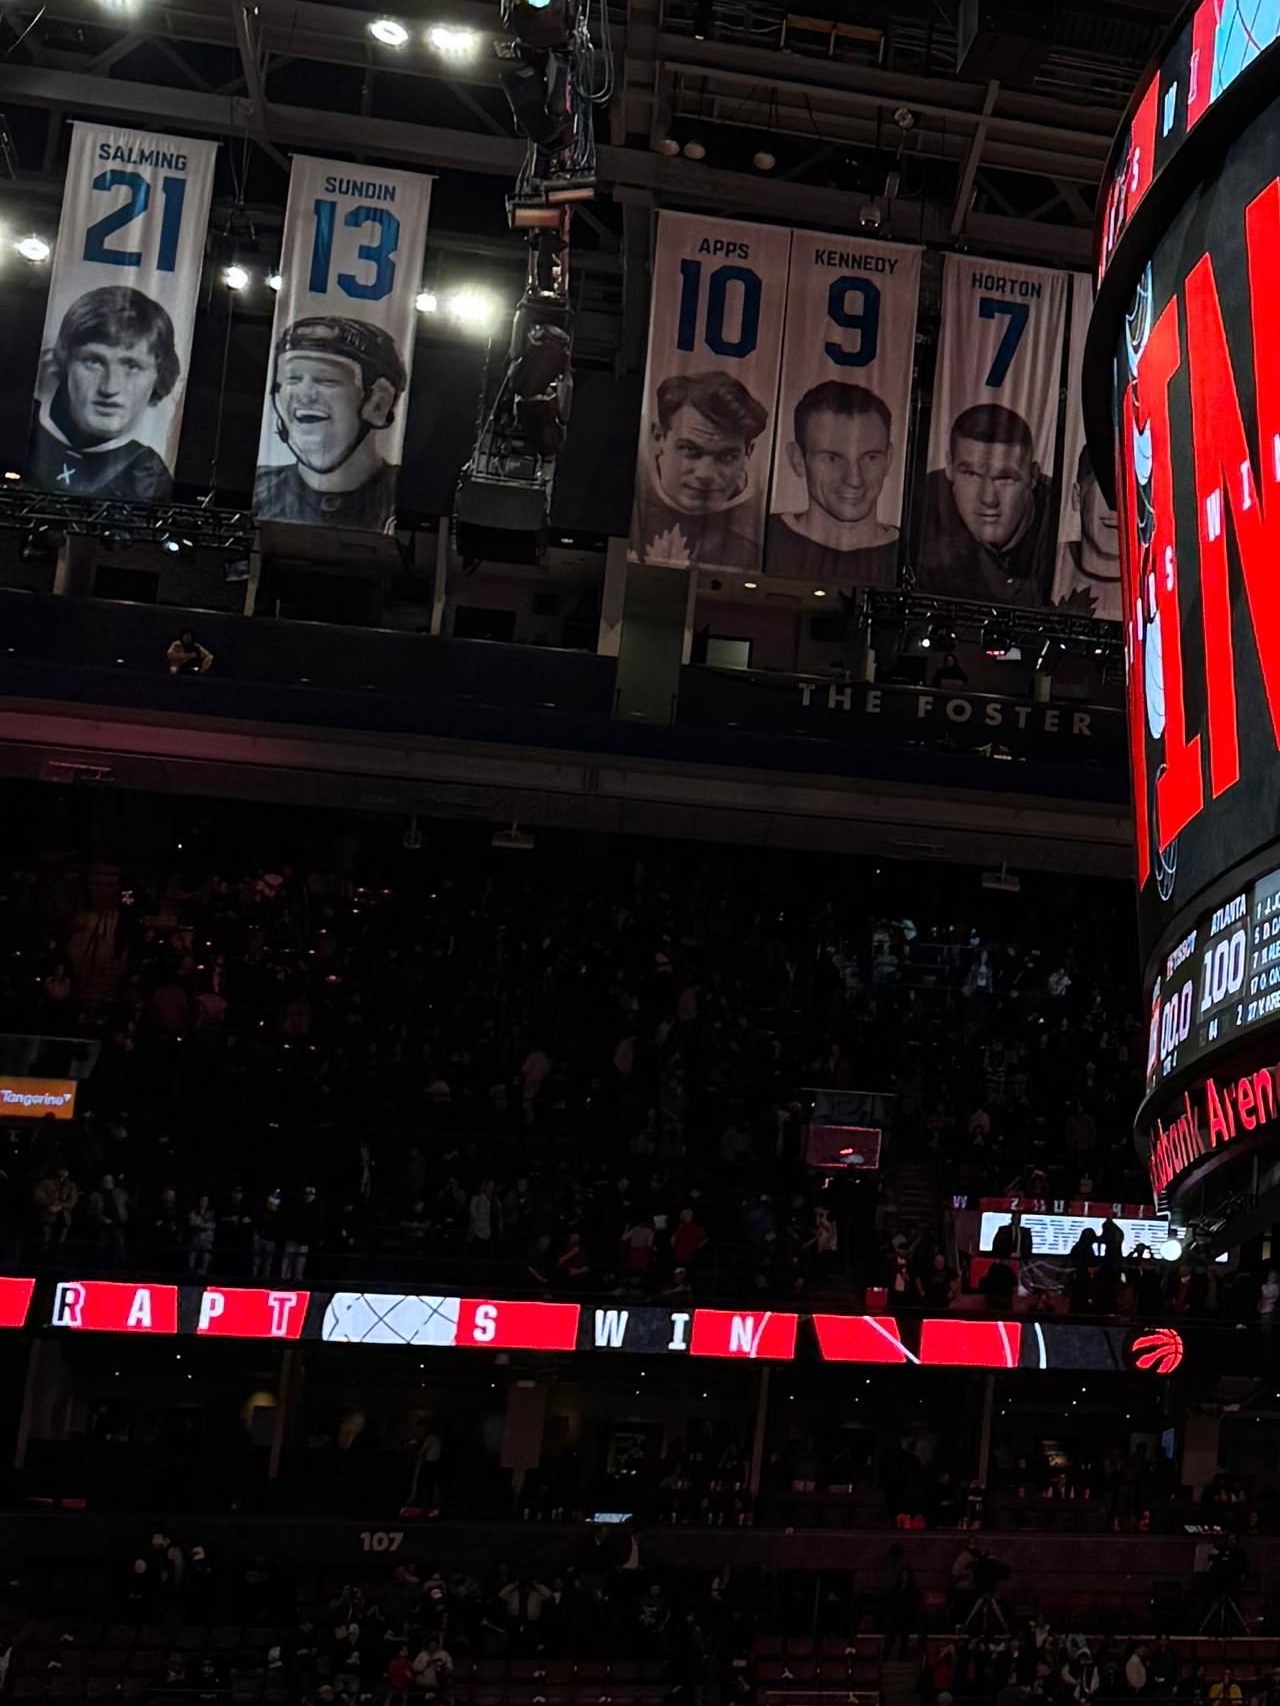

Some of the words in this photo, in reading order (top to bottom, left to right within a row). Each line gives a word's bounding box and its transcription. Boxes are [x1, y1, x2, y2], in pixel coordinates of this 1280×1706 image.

[99, 143, 187, 171] SALMING
[325, 176, 396, 202] SUNDIN
[83, 169, 186, 272] 21
[309, 198, 400, 301] 13
[699, 238, 749, 260] APPS
[815, 249, 898, 274] KENNEDY
[677, 258, 762, 359] 10
[972, 272, 1042, 299] HORTON
[825, 275, 881, 367] 9
[978, 297, 1030, 388] 7
[800, 683, 881, 713] THE
[918, 695, 1093, 736] FOSTER
[1210, 893, 1246, 936] ATLANTA
[1201, 929, 1246, 1012] 100
[360, 1532, 404, 1553] 107
